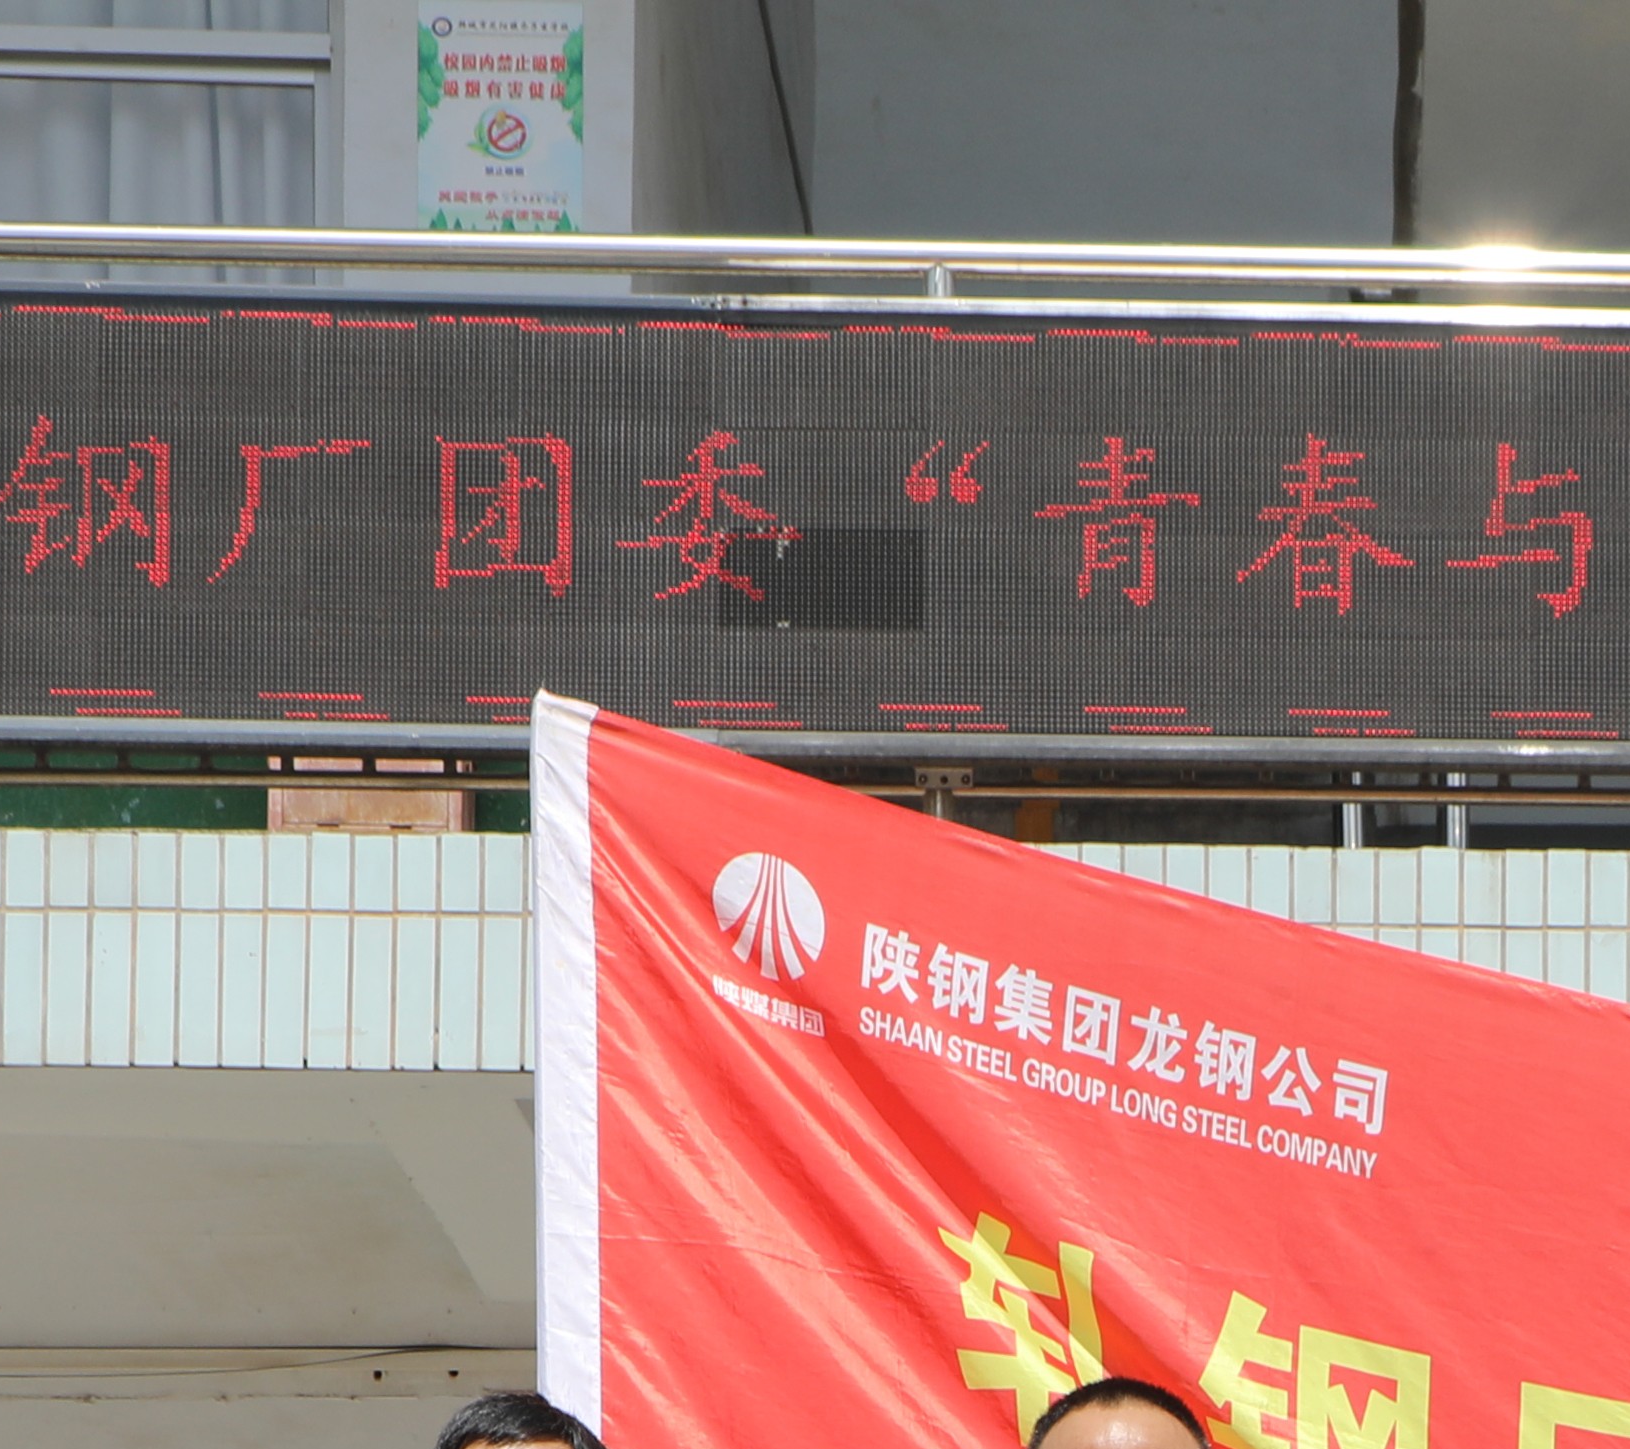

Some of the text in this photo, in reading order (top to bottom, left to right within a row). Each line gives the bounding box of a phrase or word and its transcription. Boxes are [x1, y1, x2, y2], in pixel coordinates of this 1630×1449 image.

[443, 79, 567, 100] 吸烟有害健康
[444, 52, 567, 72] 校园内禁止吸烟
[860, 922, 1390, 1136] 陕钢集团龙钢公司
[858, 1006, 1378, 1180] SHAAN STEEL GROUP LONG STEEL COMPANY
